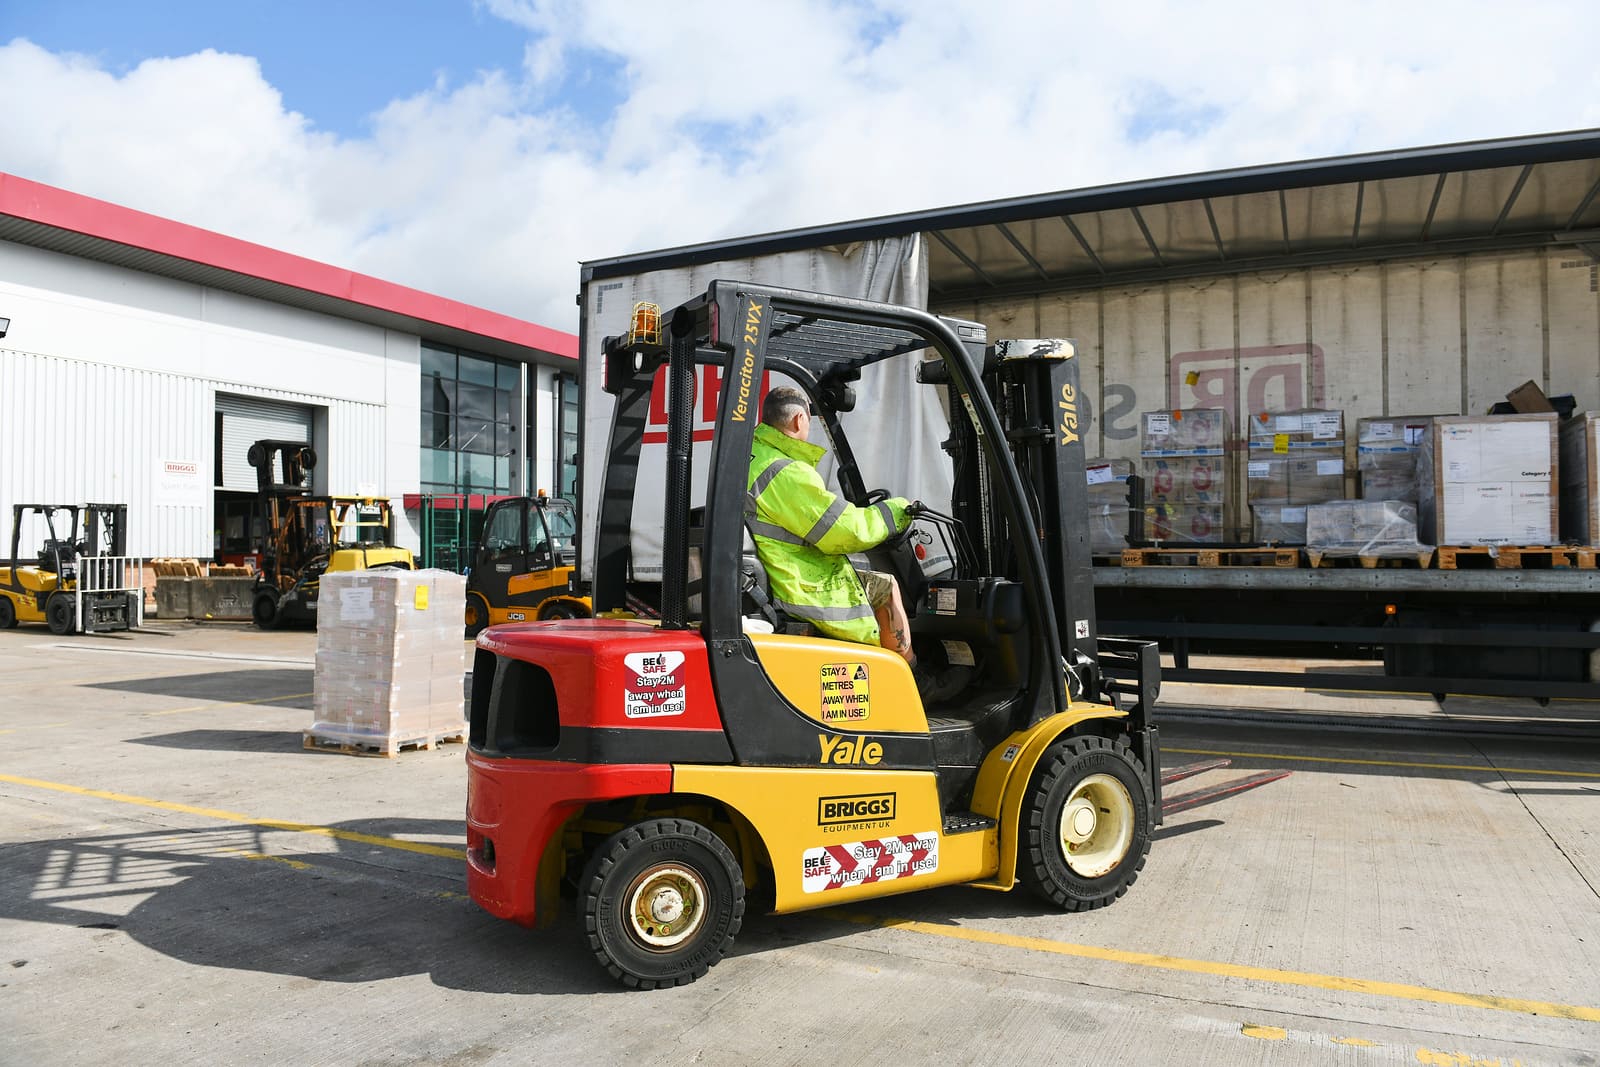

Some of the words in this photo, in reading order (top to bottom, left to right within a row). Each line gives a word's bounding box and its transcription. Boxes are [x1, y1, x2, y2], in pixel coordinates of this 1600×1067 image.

[732, 349, 755, 421] Veracitor
[744, 300, 762, 345] 25VX
[1059, 383, 1079, 446] Yale
[167, 464, 195, 472] BRIGGS
[643, 665, 666, 673] SAFE
[821, 667, 840, 676] STAY
[841, 667, 847, 676] 2
[637, 677, 659, 688] Stay
[660, 675, 675, 685] 2M
[822, 681, 854, 690] METRES
[629, 692, 654, 702] away
[656, 689, 684, 699] when
[823, 695, 844, 705] AWAY
[845, 694, 869, 703] WHEN
[628, 704, 632, 715] I
[633, 705, 649, 715] am
[651, 703, 661, 713] in
[662, 701, 685, 712] use!
[826, 710, 838, 719] AM
[839, 709, 847, 718] IN
[848, 708, 866, 717] USE!
[818, 733, 884, 765] Yale
[824, 799, 890, 818] BRIGGS
[823, 822, 876, 833] EQUIPMENT
[853, 845, 881, 860] Stay
[884, 840, 903, 855] 2M
[905, 837, 937, 852] away
[804, 858, 819, 868] BE
[830, 870, 866, 884] when
[875, 865, 894, 877] am
[896, 860, 909, 873] in
[911, 855, 937, 871] use!
[804, 865, 831, 878] SAFE
